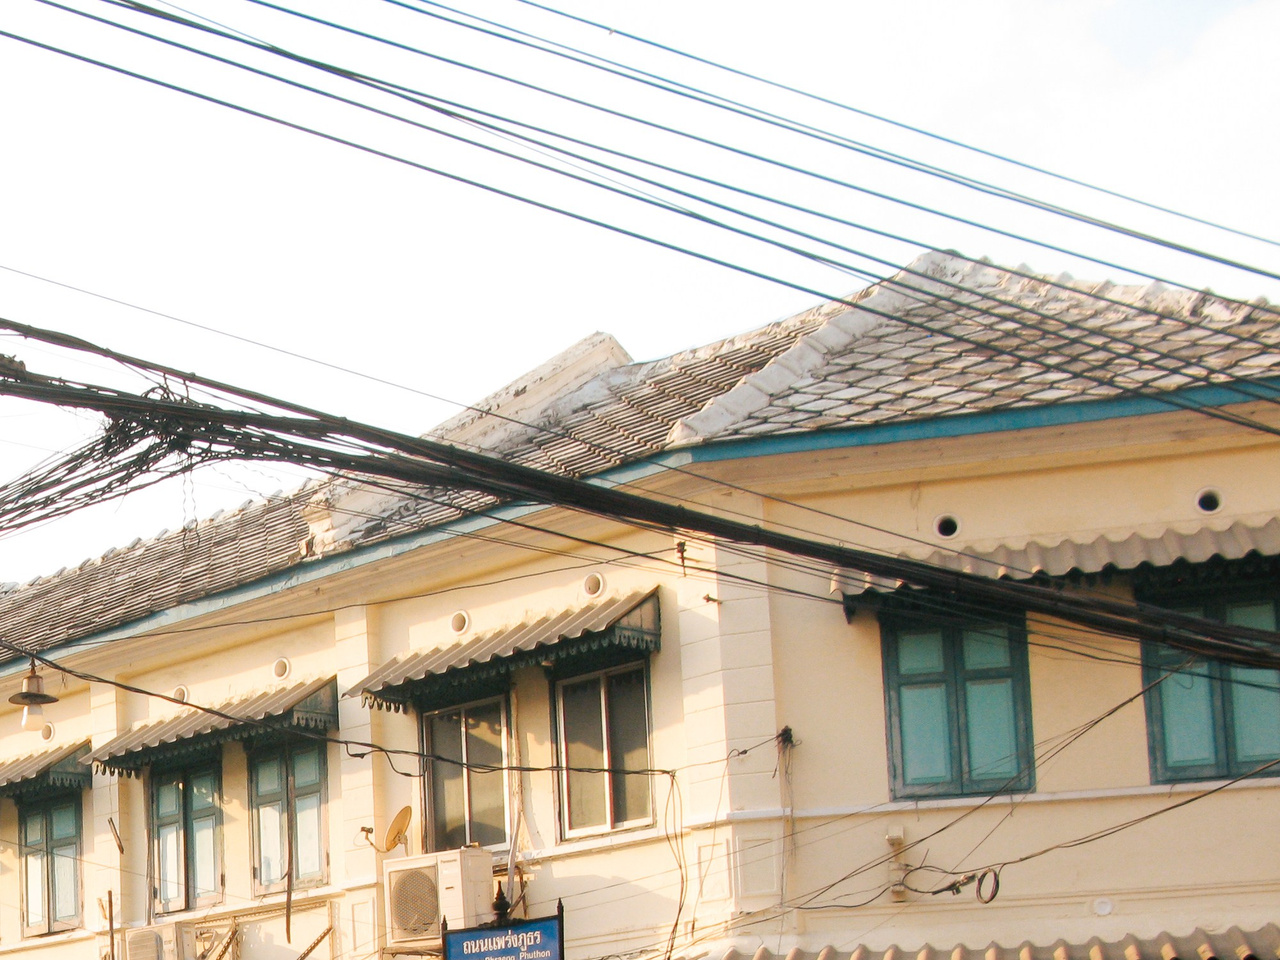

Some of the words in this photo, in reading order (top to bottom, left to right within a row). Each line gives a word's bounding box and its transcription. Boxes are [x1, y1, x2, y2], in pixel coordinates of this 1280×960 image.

[463, 930, 541, 954] ถนนแพร่งภูธร
[519, 949, 551, 960] Phuthon
